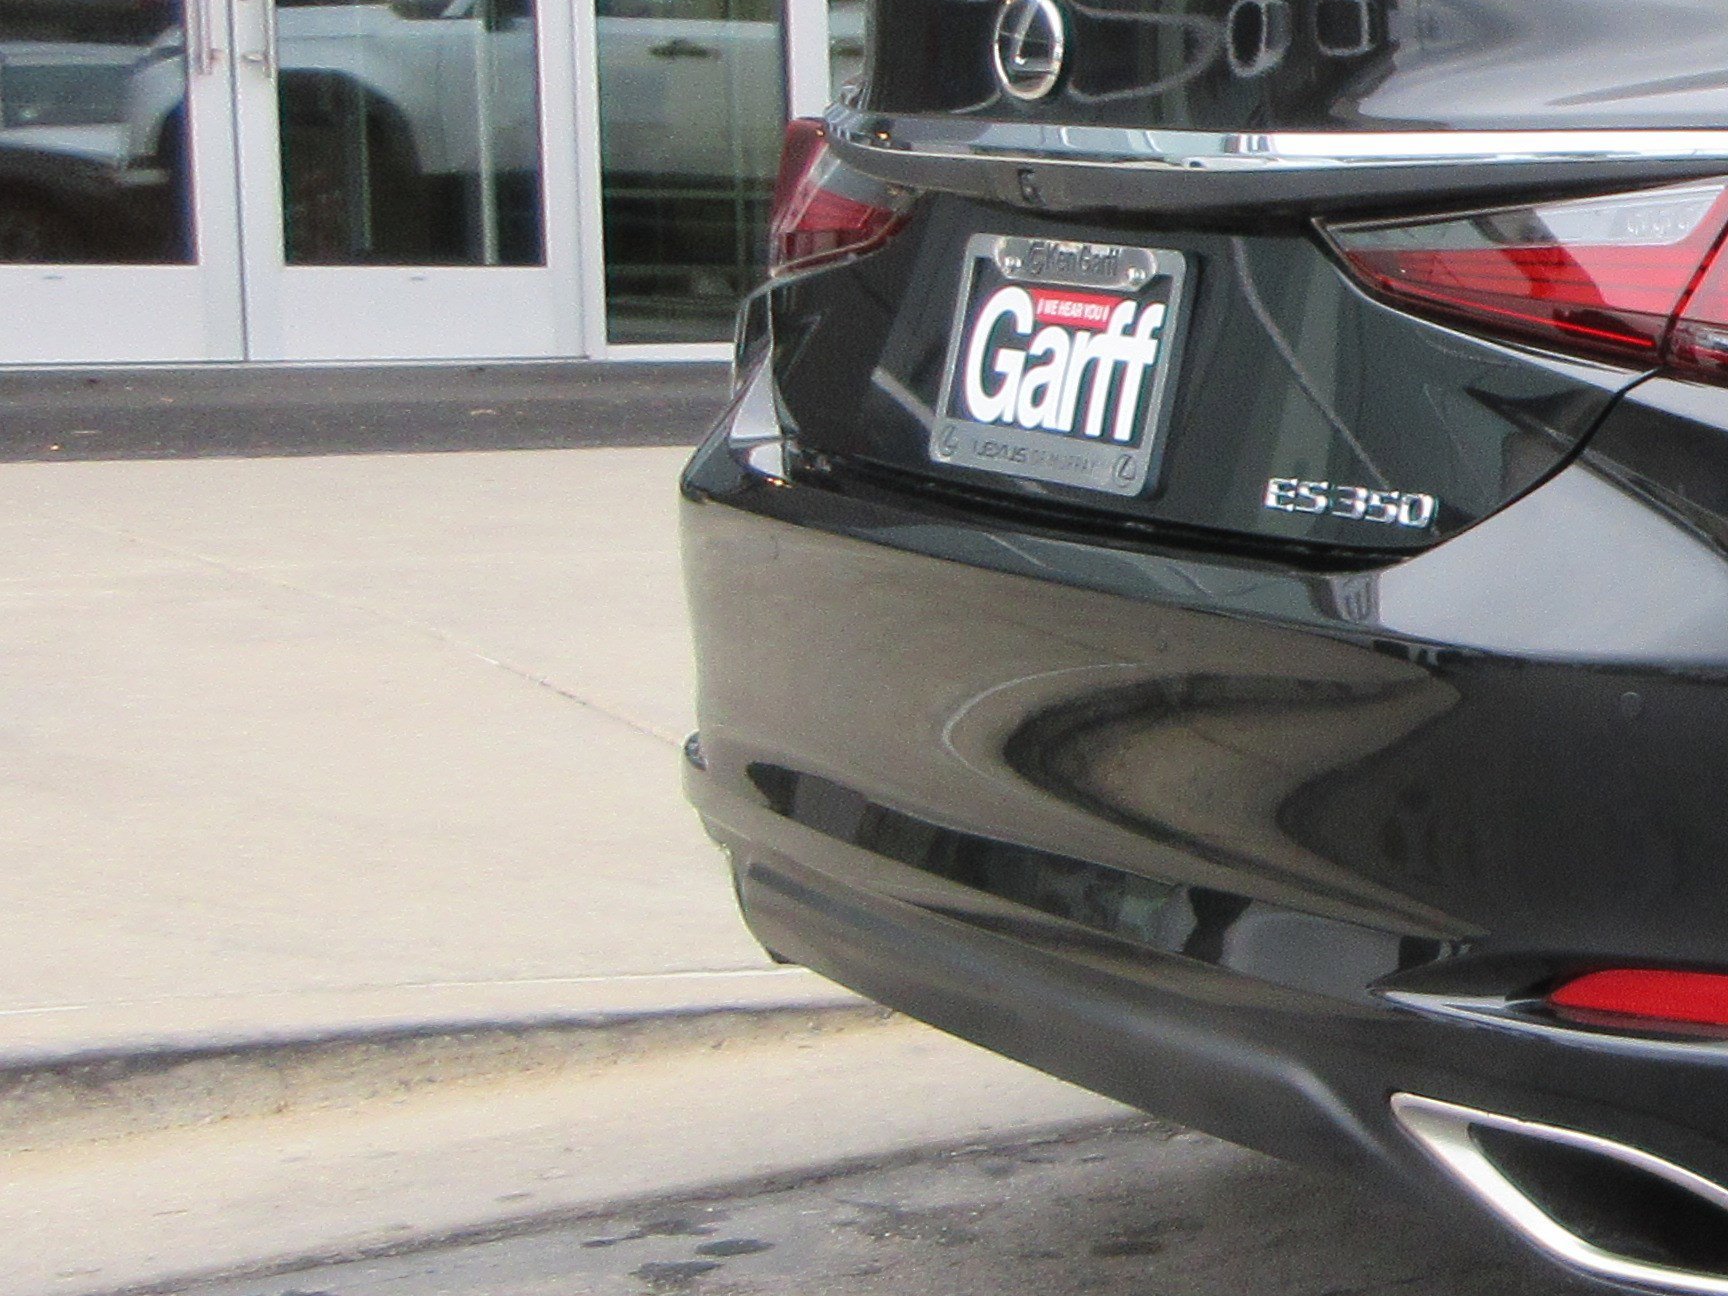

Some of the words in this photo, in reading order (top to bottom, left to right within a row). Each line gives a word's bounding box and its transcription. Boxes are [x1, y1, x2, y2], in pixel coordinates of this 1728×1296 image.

[964, 285, 1166, 442] Garff
[1264, 477, 1329, 515] ES
[1331, 485, 1436, 529] 350
